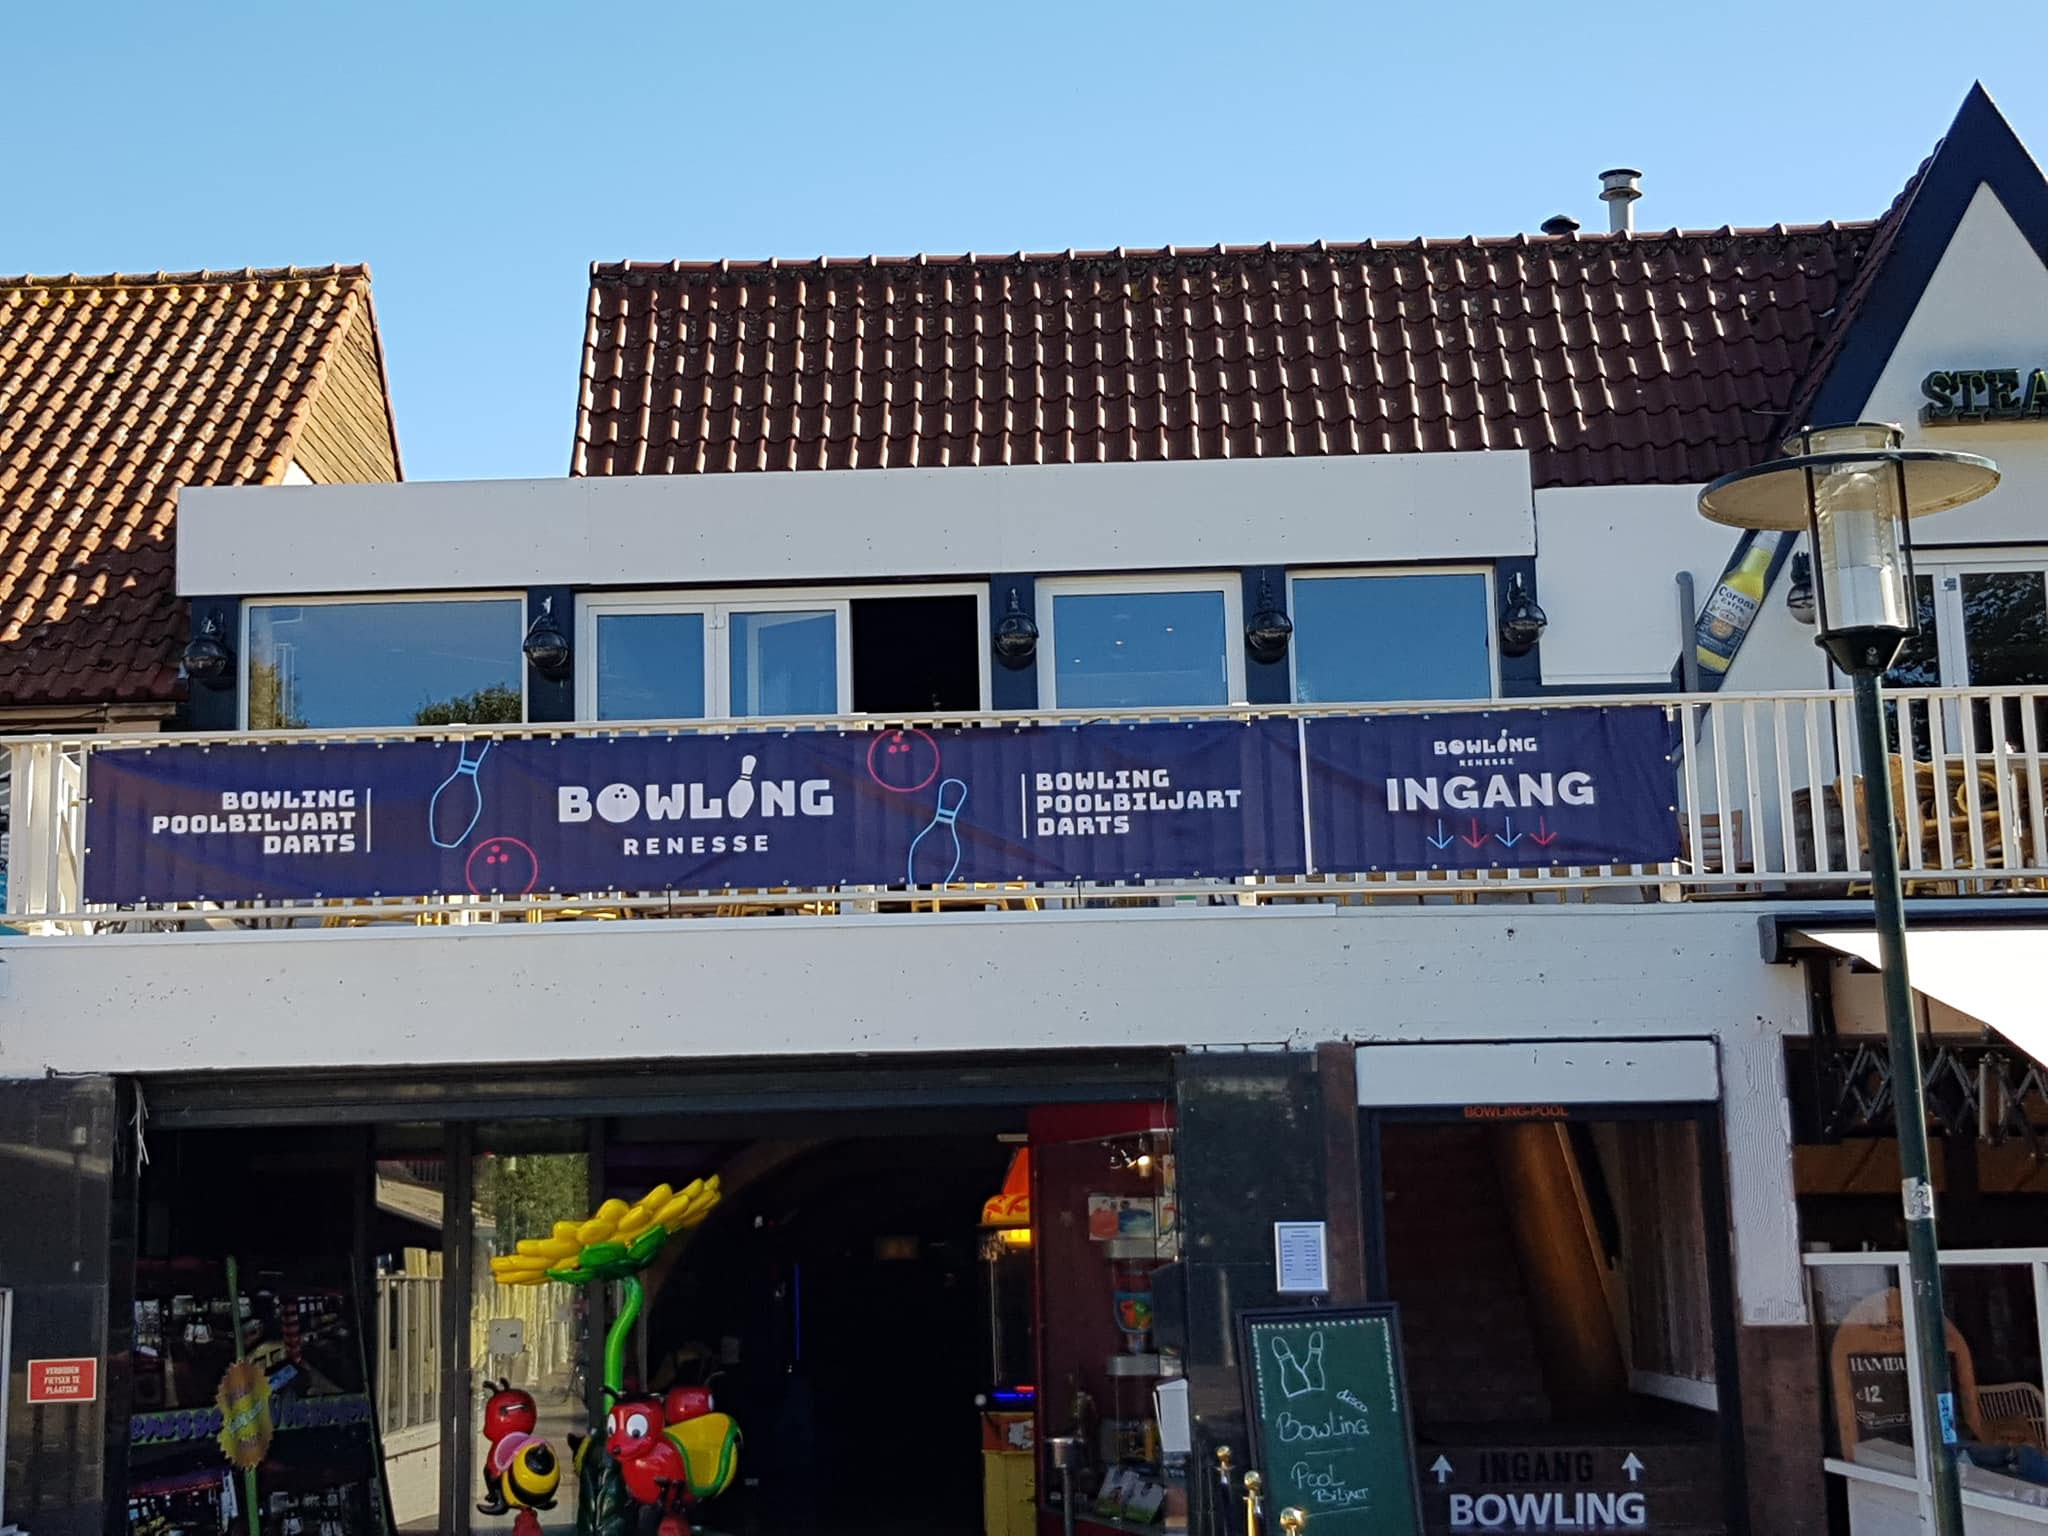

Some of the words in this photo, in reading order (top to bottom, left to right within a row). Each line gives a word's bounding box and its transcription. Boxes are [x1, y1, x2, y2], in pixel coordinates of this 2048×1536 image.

[1433, 728, 1538, 756] BOWLING
[1458, 757, 1515, 767] RENESSE
[557, 754, 834, 824] BOWLING
[1035, 769, 1171, 792] BOWLING
[1386, 771, 1595, 812] INGANG
[221, 789, 356, 811] BOWLING
[1036, 789, 1242, 814] POOLBILJART
[152, 811, 356, 834] POOLBILJART
[1036, 815, 1131, 837] DARTS
[263, 833, 356, 854] DARTS
[623, 834, 770, 856] RENESSE
[1450, 1492, 1645, 1526] BOWLING
